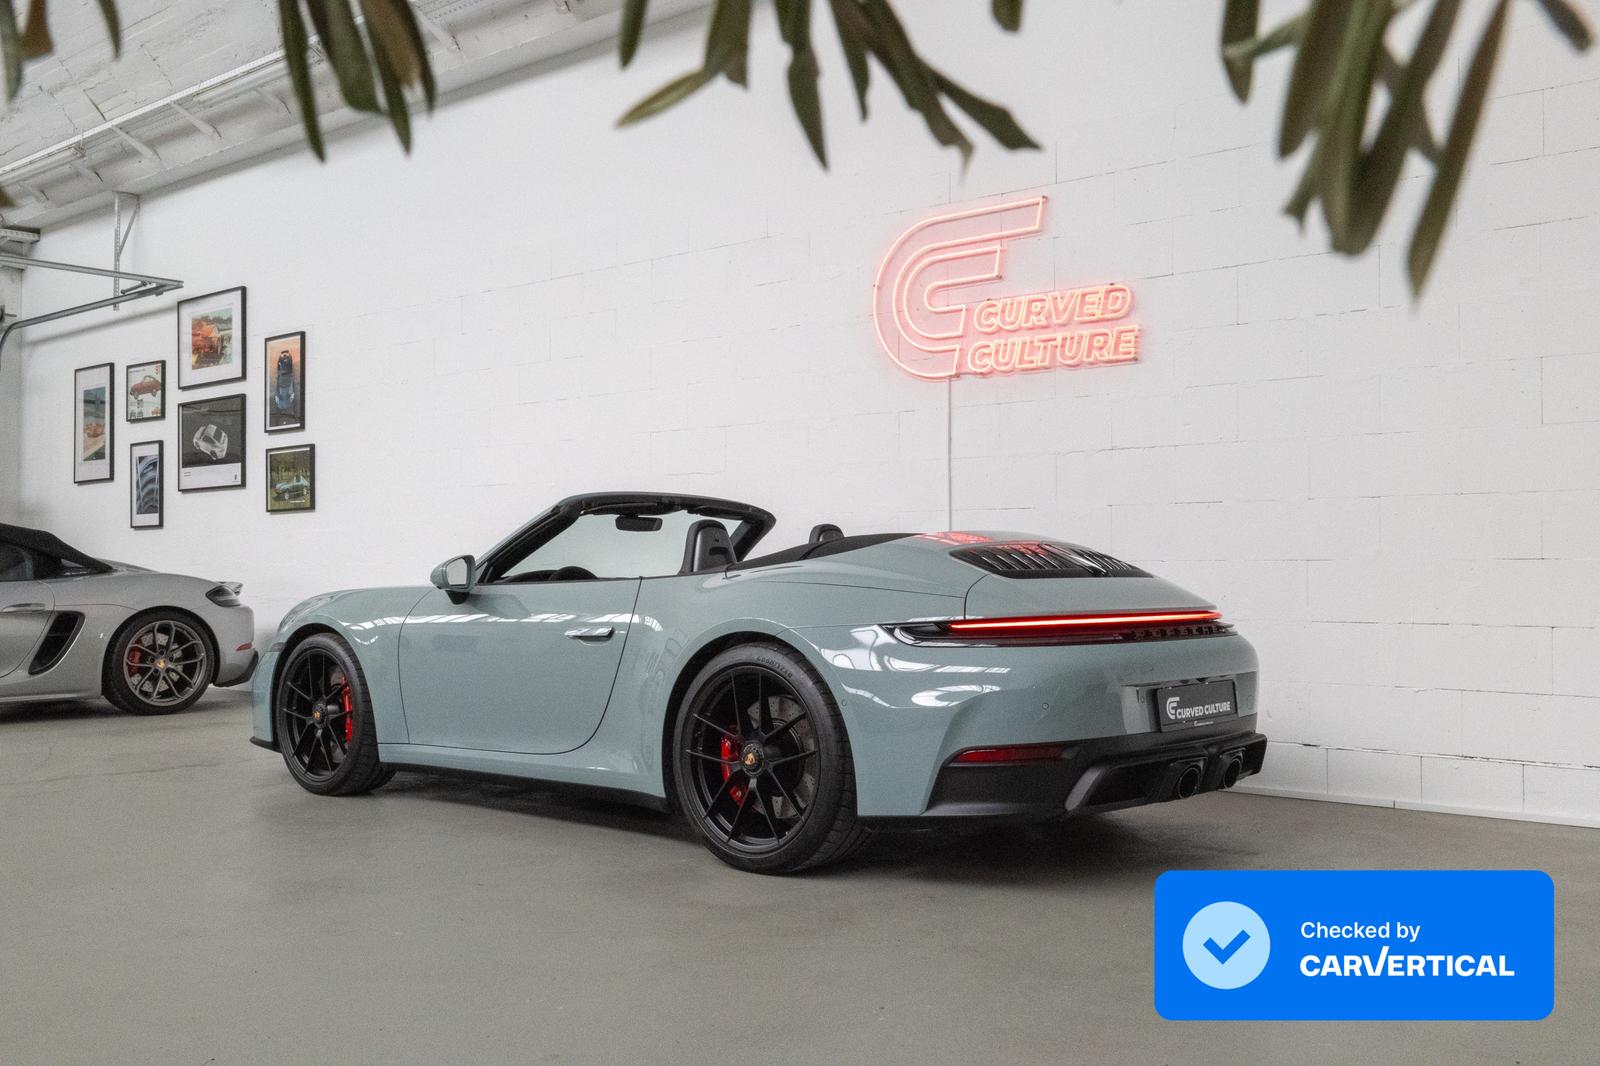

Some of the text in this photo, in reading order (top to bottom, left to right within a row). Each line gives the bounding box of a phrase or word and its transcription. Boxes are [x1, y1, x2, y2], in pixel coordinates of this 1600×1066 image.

[974, 284, 1132, 332] CURVED
[968, 326, 1140, 373] CULTURE
[1176, 701, 1231, 719] CURVED CULTURE
